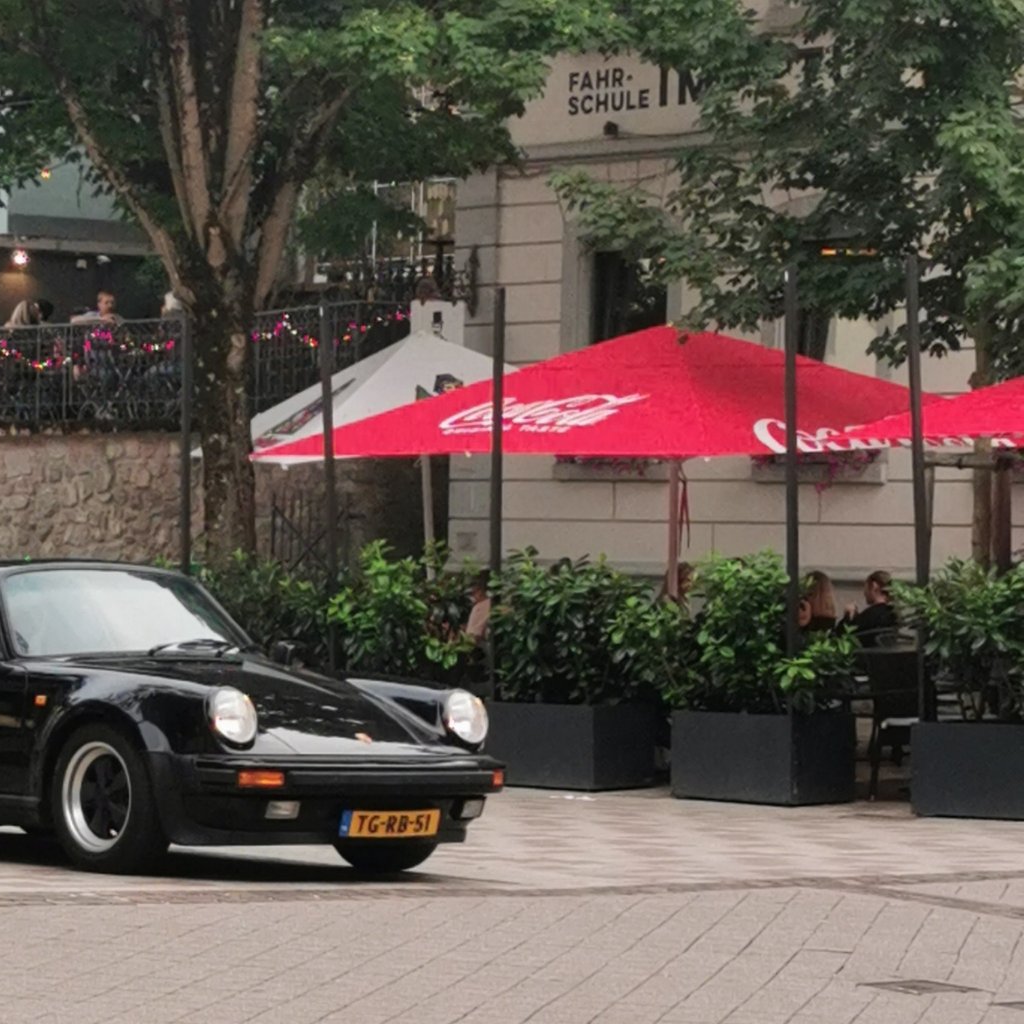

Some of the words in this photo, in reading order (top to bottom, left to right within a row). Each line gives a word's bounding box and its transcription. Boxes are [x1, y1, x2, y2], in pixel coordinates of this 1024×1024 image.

[568, 67, 633, 92] FAHR-
[568, 88, 650, 116] SCHULE
[357, 814, 431, 833] TG-RB-51
